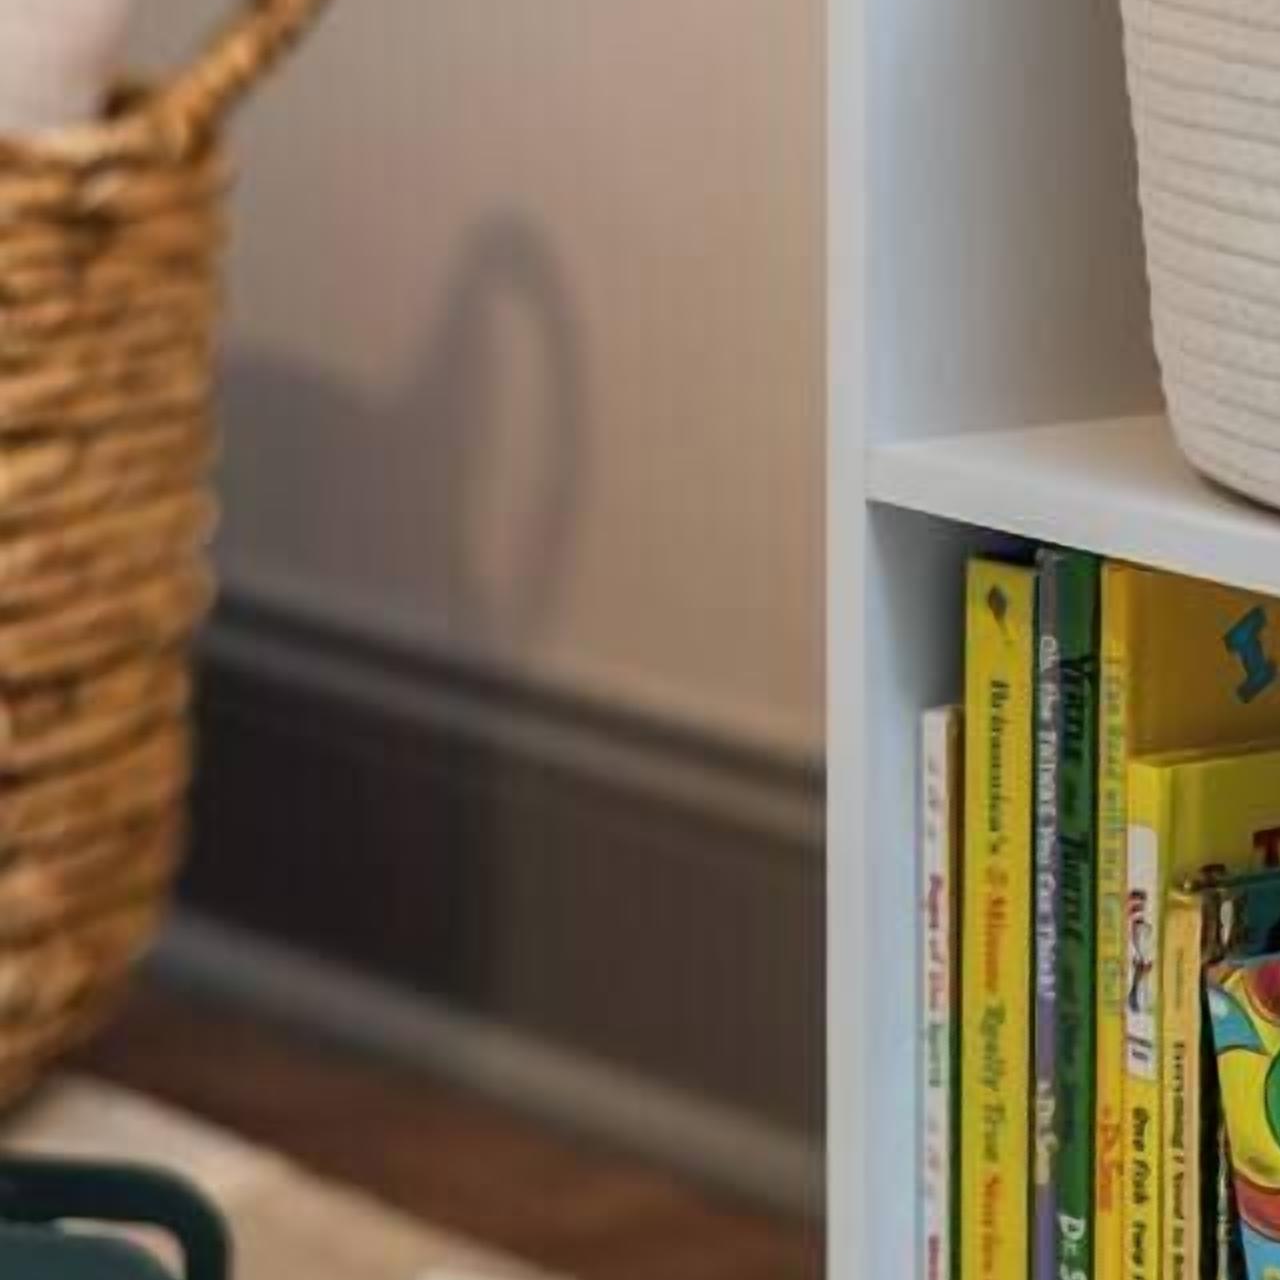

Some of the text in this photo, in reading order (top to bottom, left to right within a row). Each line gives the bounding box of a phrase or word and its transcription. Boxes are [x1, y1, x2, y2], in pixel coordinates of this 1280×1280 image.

[1224, 604, 1277, 704] I
[1132, 1158, 1152, 1205] fish
[1131, 1220, 1148, 1267] two
